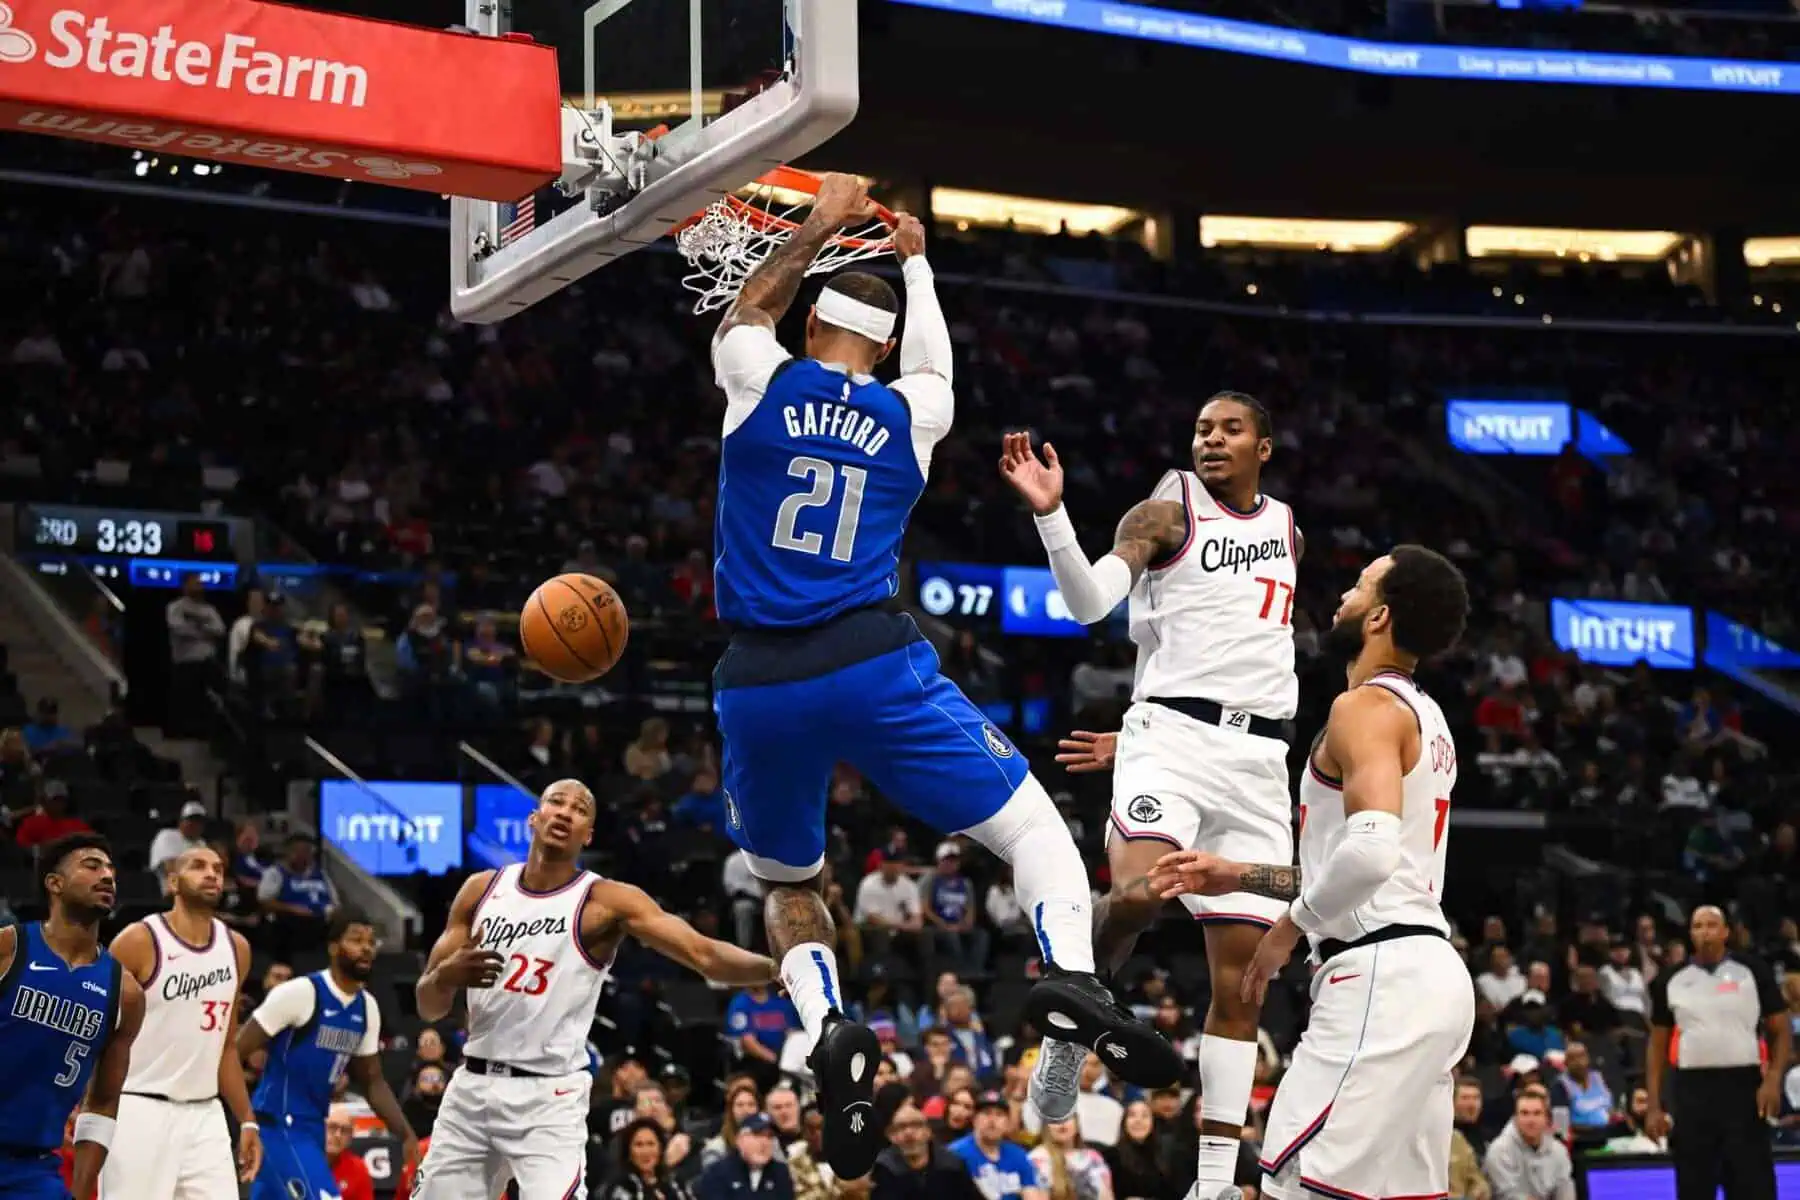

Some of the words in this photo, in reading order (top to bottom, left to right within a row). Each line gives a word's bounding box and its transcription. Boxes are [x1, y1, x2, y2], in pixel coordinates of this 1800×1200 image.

[783, 402, 890, 456] GAFFORD
[1464, 414, 1553, 441] INTUIT
[772, 456, 867, 562] 21
[97, 518, 163, 555] 3:33
[1201, 536, 1288, 574] Clippers
[957, 583, 994, 615] 77
[1254, 576, 1294, 626] 77
[1569, 615, 1676, 652] INTUIT
[335, 812, 444, 843] INTUIT
[162, 965, 232, 1001] Clippers
[503, 953, 556, 996] 23
[11, 985, 104, 1041] DALLAS
[54, 1040, 91, 1087] 5
